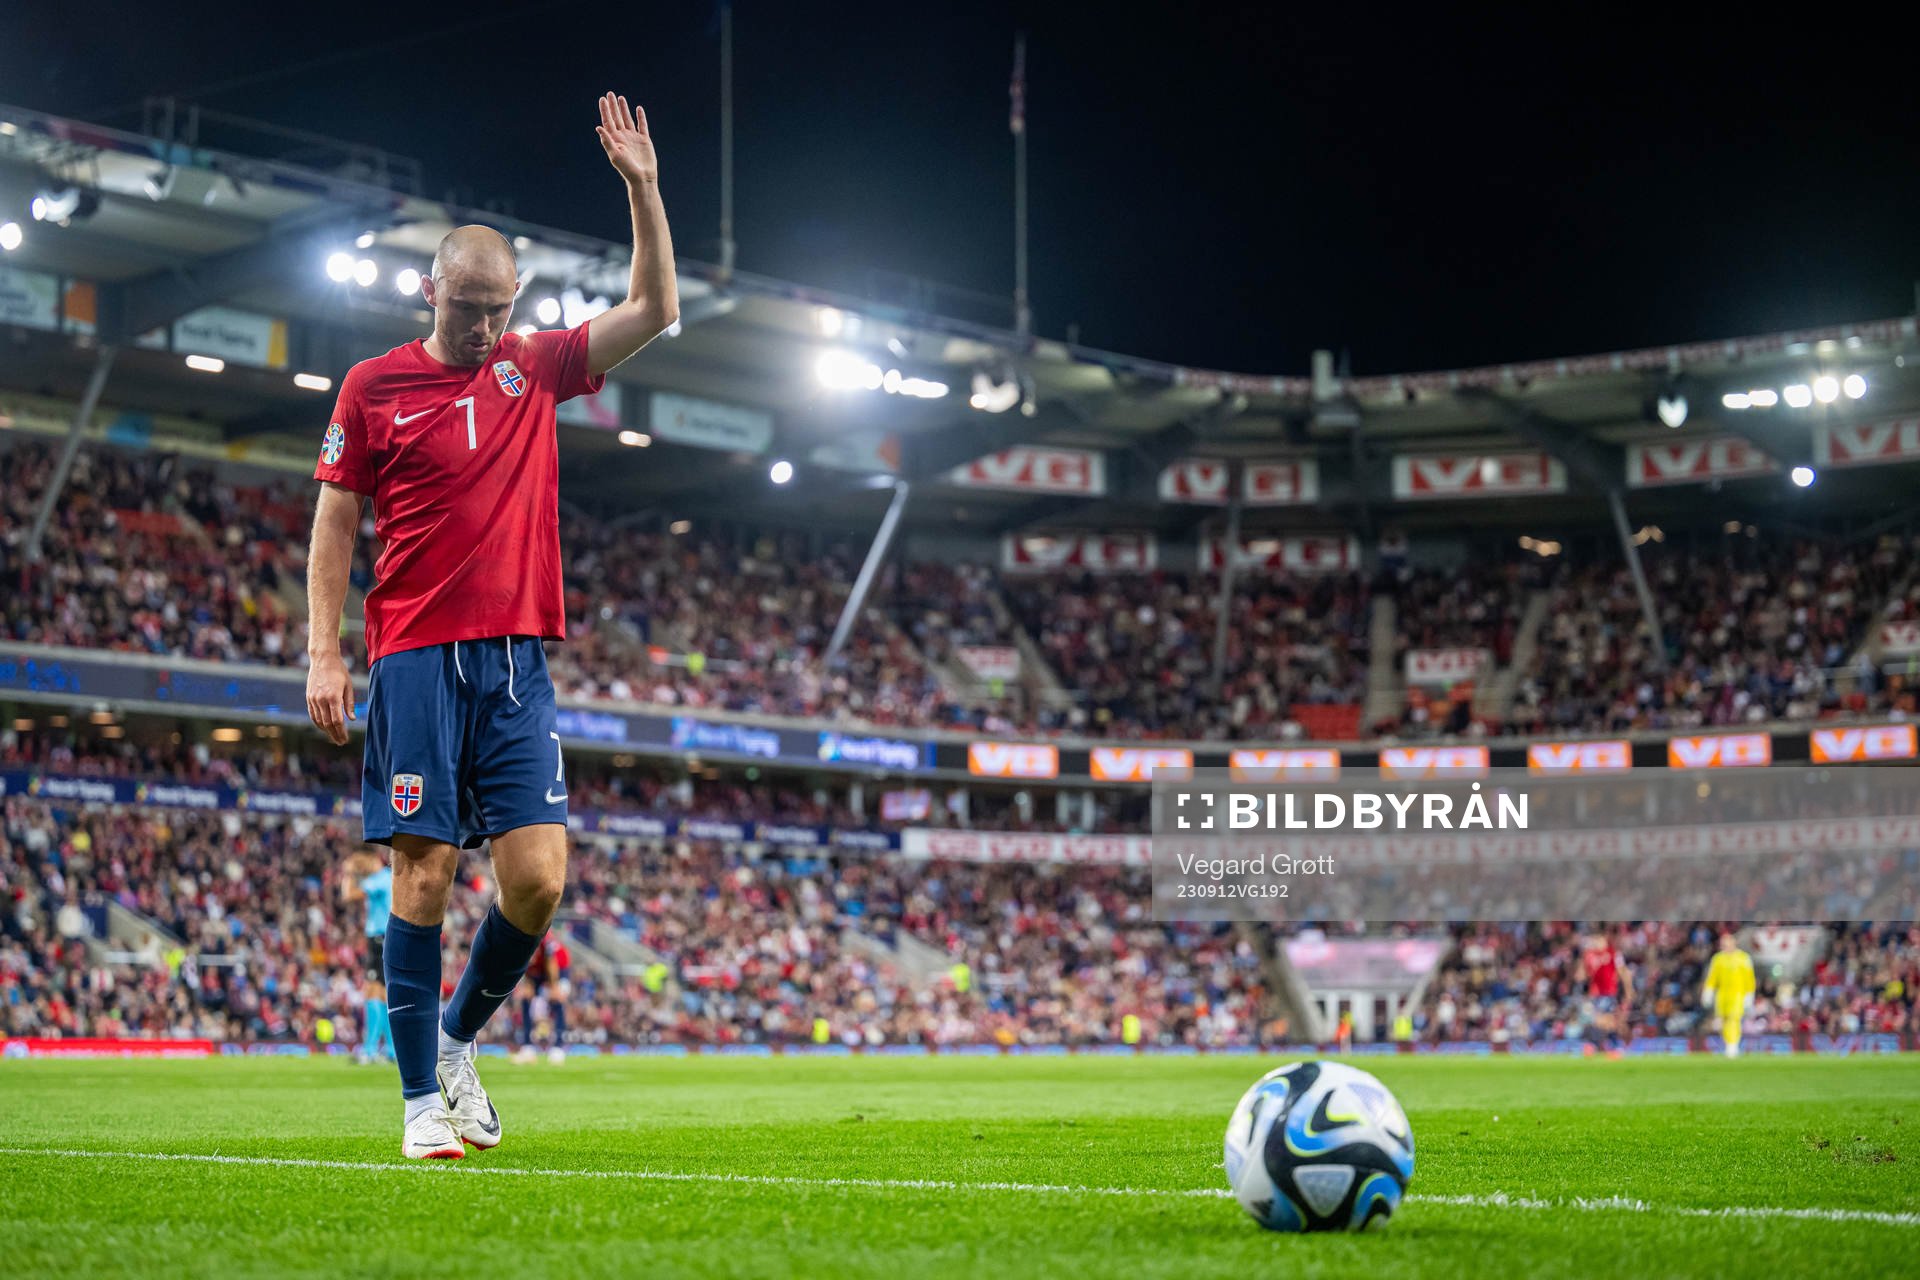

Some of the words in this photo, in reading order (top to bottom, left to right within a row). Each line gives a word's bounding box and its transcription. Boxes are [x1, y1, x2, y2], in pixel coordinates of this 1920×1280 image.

[455, 396, 477, 450] 7
[1411, 455, 1546, 492] VG
[549, 731, 563, 782] 7
[971, 743, 1053, 778] VG
[1530, 742, 1624, 774] VG
[1671, 735, 1763, 769] VG
[1814, 727, 1911, 761] VG
[1094, 748, 1187, 782] VG
[1233, 750, 1334, 782] VG
[1382, 747, 1482, 780] VG
